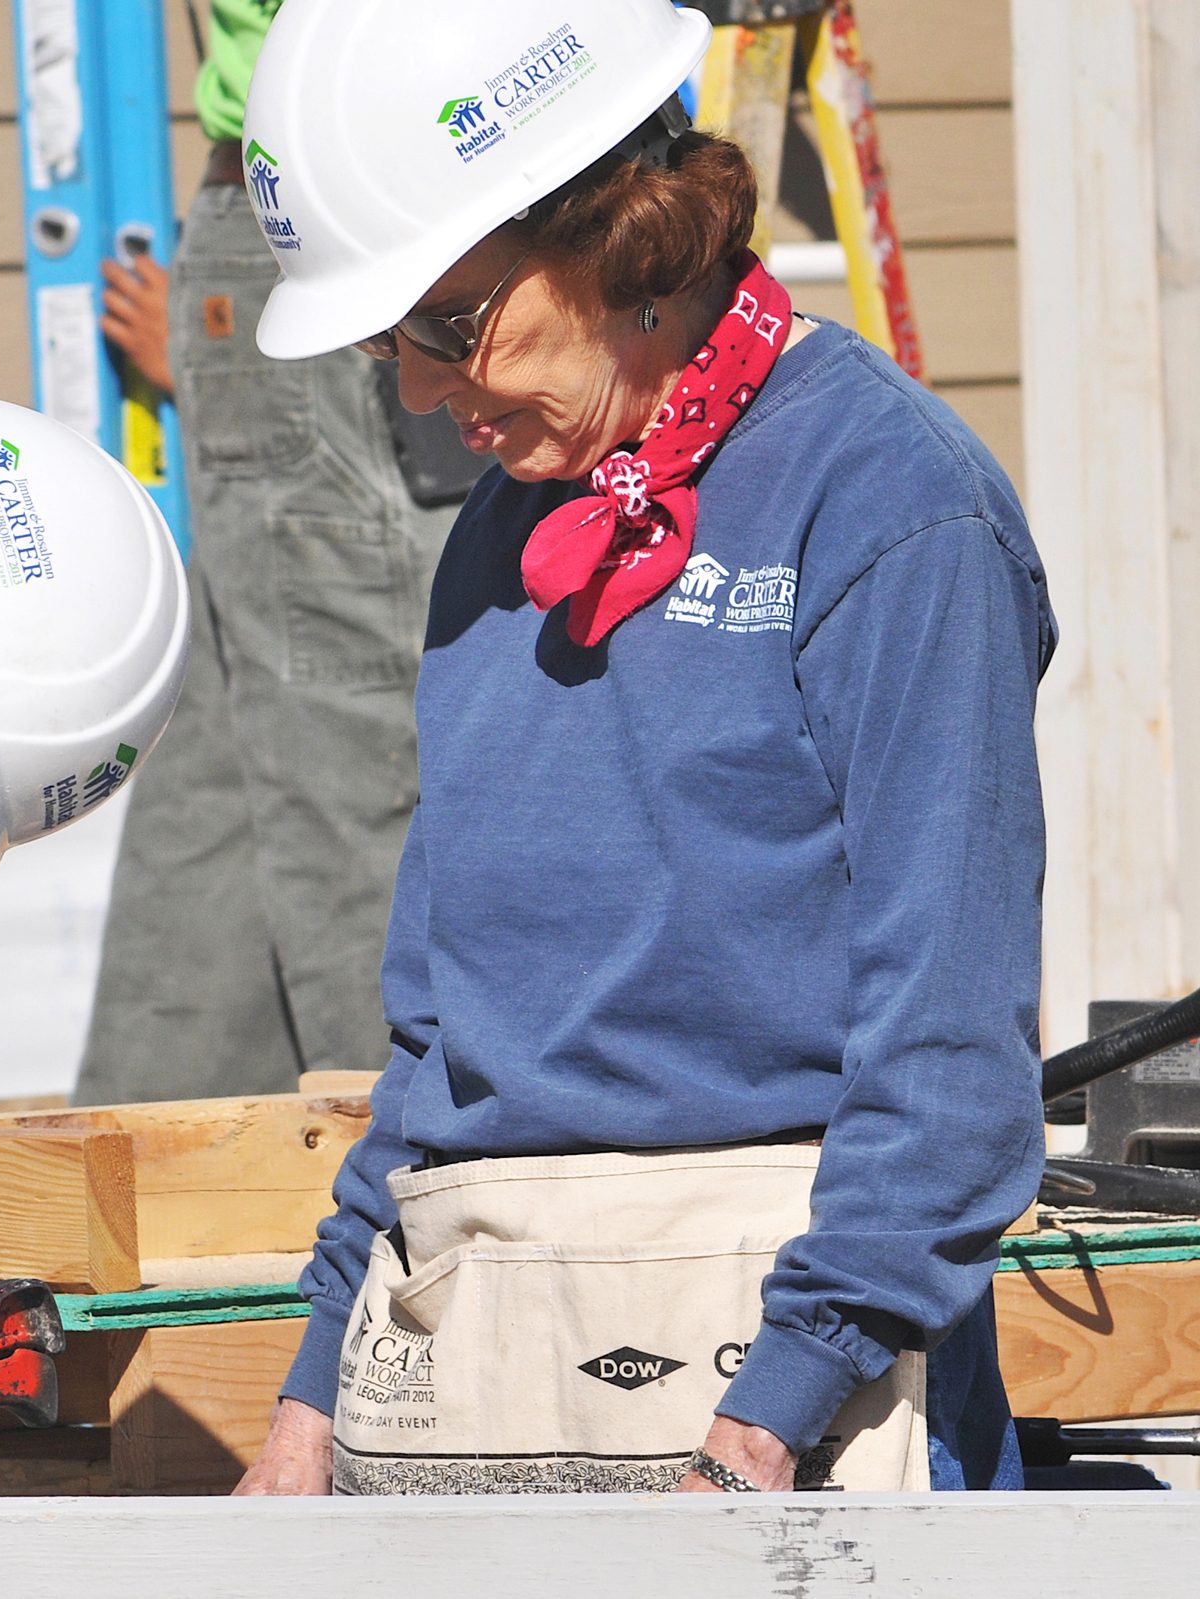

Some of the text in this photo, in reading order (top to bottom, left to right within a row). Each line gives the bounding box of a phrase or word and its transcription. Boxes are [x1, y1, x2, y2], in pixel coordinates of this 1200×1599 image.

[484, 22, 572, 93] Jimmy & Rosalynn
[494, 34, 584, 108] CARTER
[505, 50, 590, 119] WORK PROJECT 2013
[455, 121, 501, 156] Habitat
[463, 132, 506, 163] for Humanity
[15, 478, 55, 580] Jimmy & Rosalynn
[8, 561, 23, 585] 2013
[666, 596, 716, 618] Habitat
[772, 604, 794, 619] 2013
[43, 785, 55, 798] for
[600, 1359, 663, 1379] DOW
[412, 1391, 435, 1403] 2012
[398, 1417, 437, 1429] EVENT
